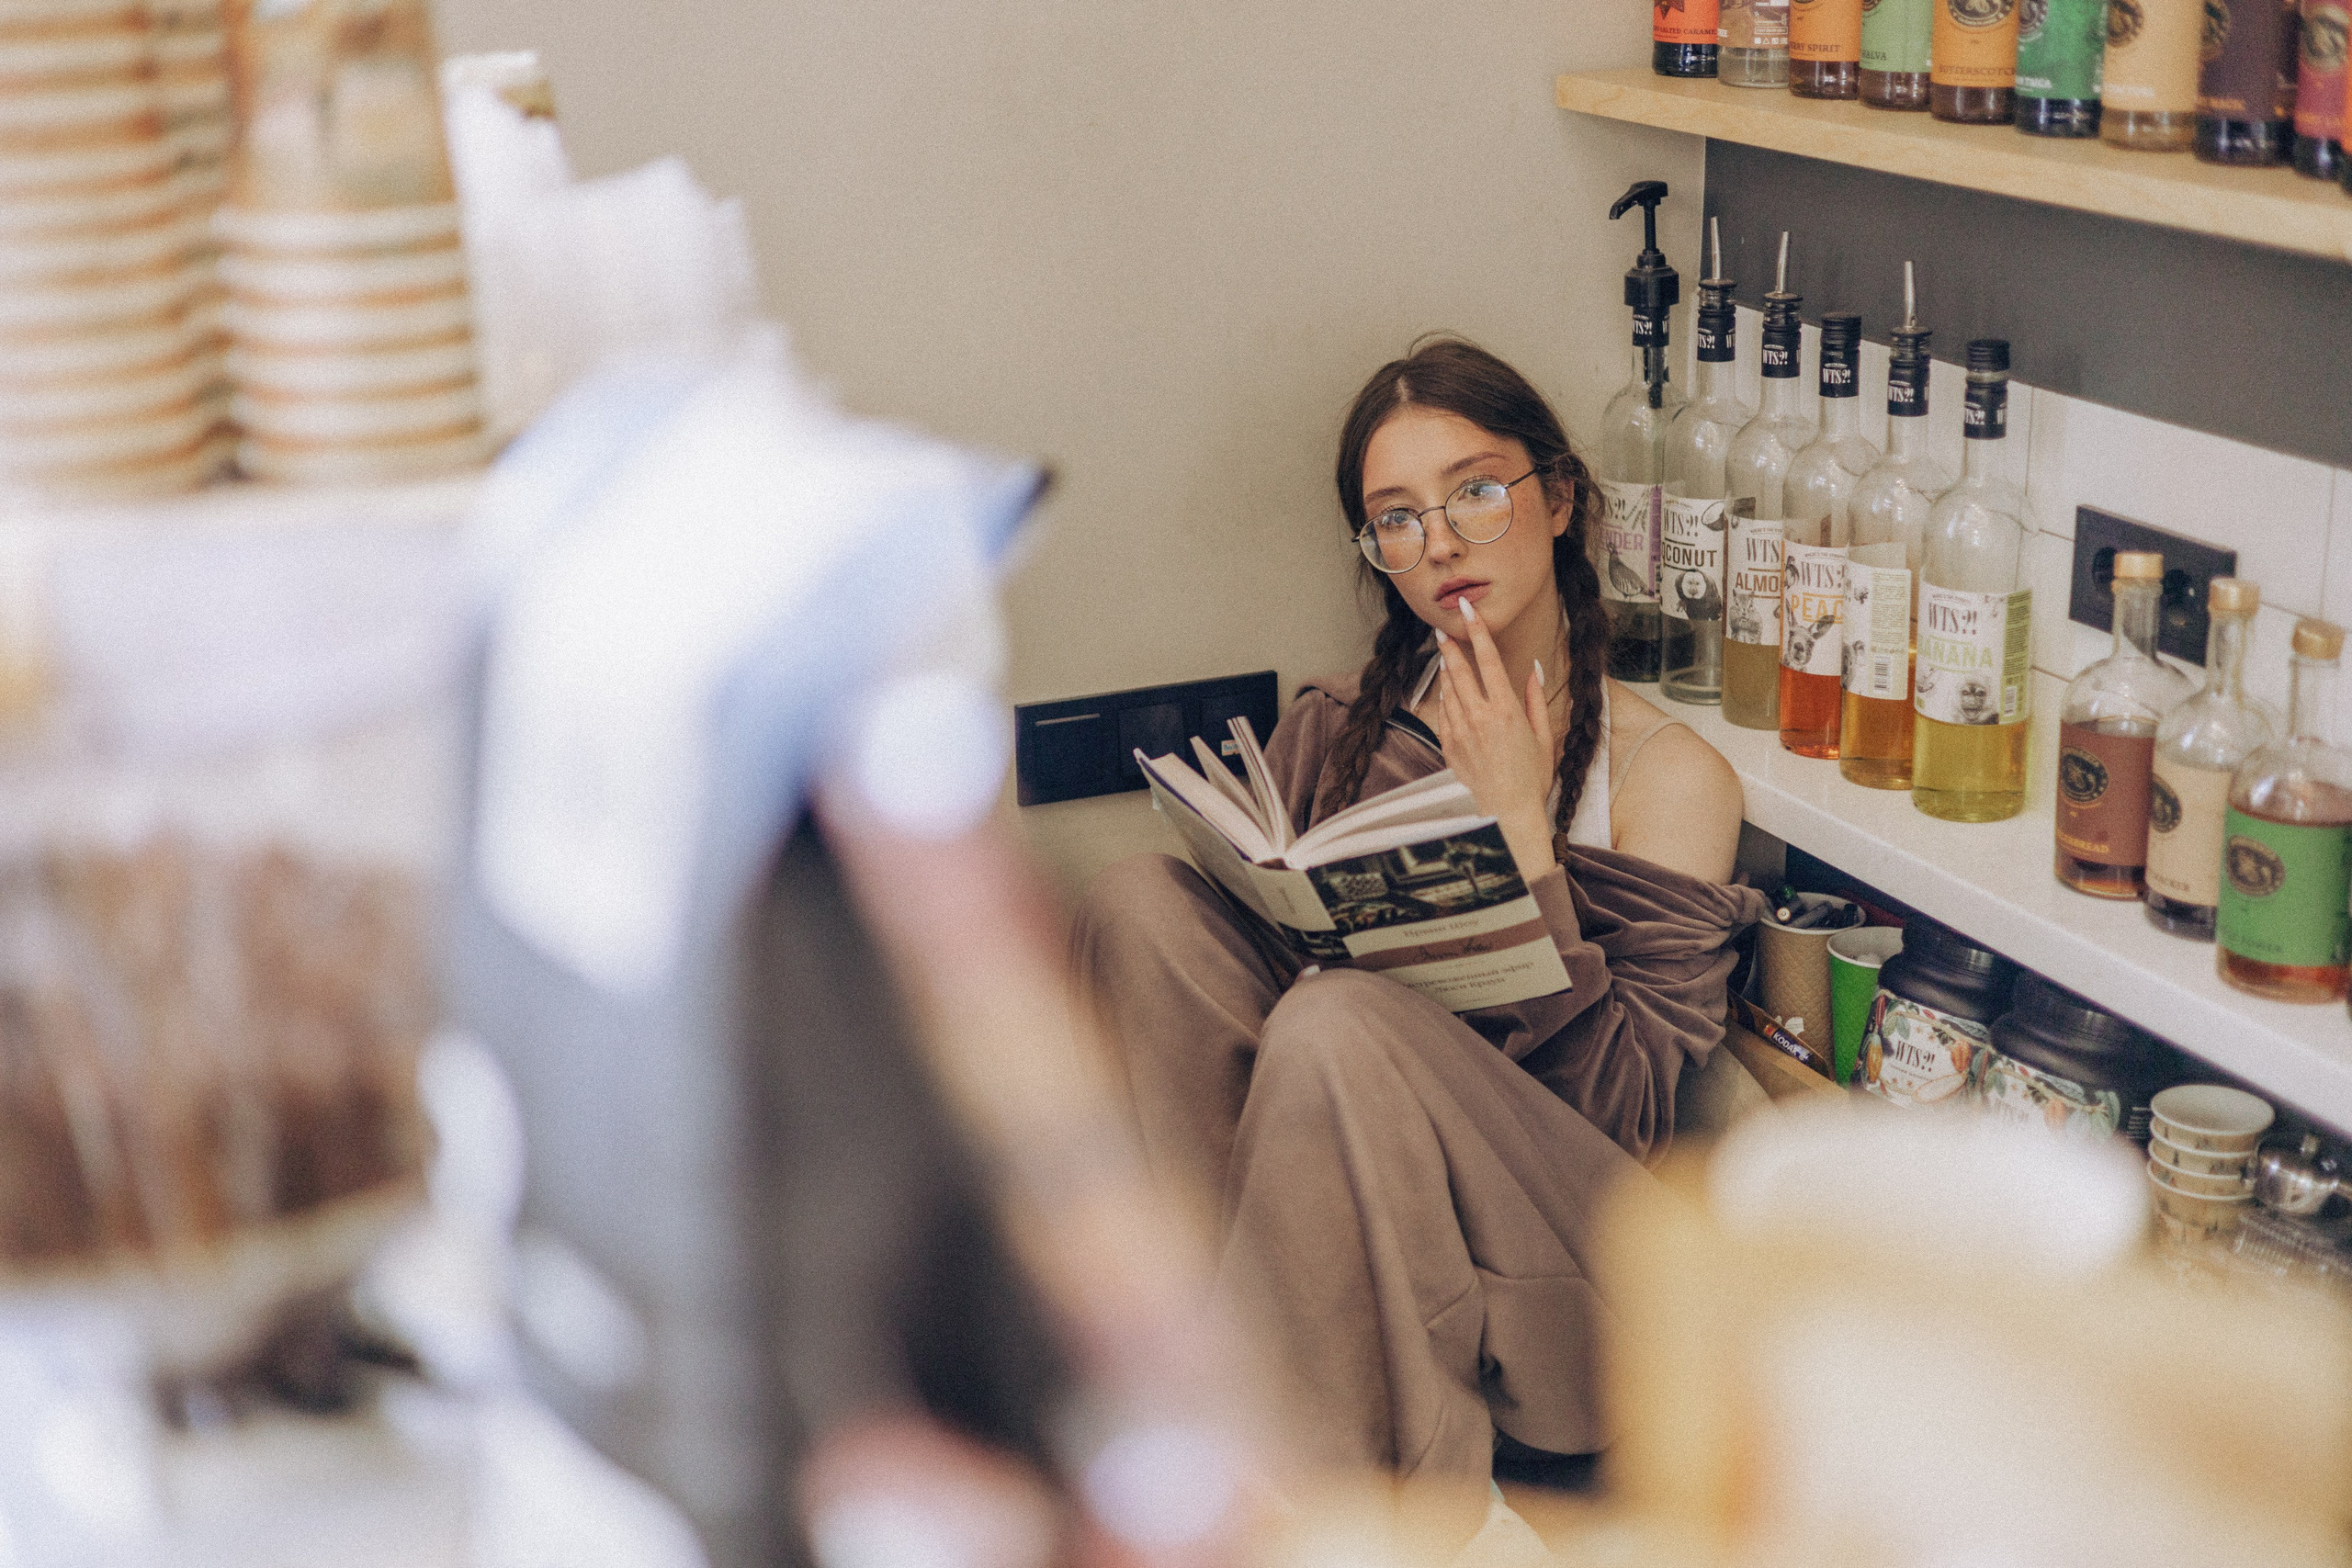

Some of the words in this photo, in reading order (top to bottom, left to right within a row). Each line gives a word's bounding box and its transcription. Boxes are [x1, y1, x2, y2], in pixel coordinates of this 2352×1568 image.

[1807, 44, 1841, 52] SPIRIT
[1633, 319, 1653, 335] TS?!
[1699, 333, 1715, 349] TS?!
[1822, 367, 1851, 384] WTS?!
[1964, 408, 1985, 426] TS?!
[1662, 541, 1717, 568] OCONUT
[1746, 537, 1781, 563] WTS
[1735, 571, 1780, 593] ALMO
[1801, 560, 1845, 589] WTS?
[1791, 593, 1844, 621] PEAC
[1928, 602, 1978, 636] WTS?!
[1772, 1031, 1798, 1057] KODAK
[1895, 1039, 1936, 1073] WTS?!
